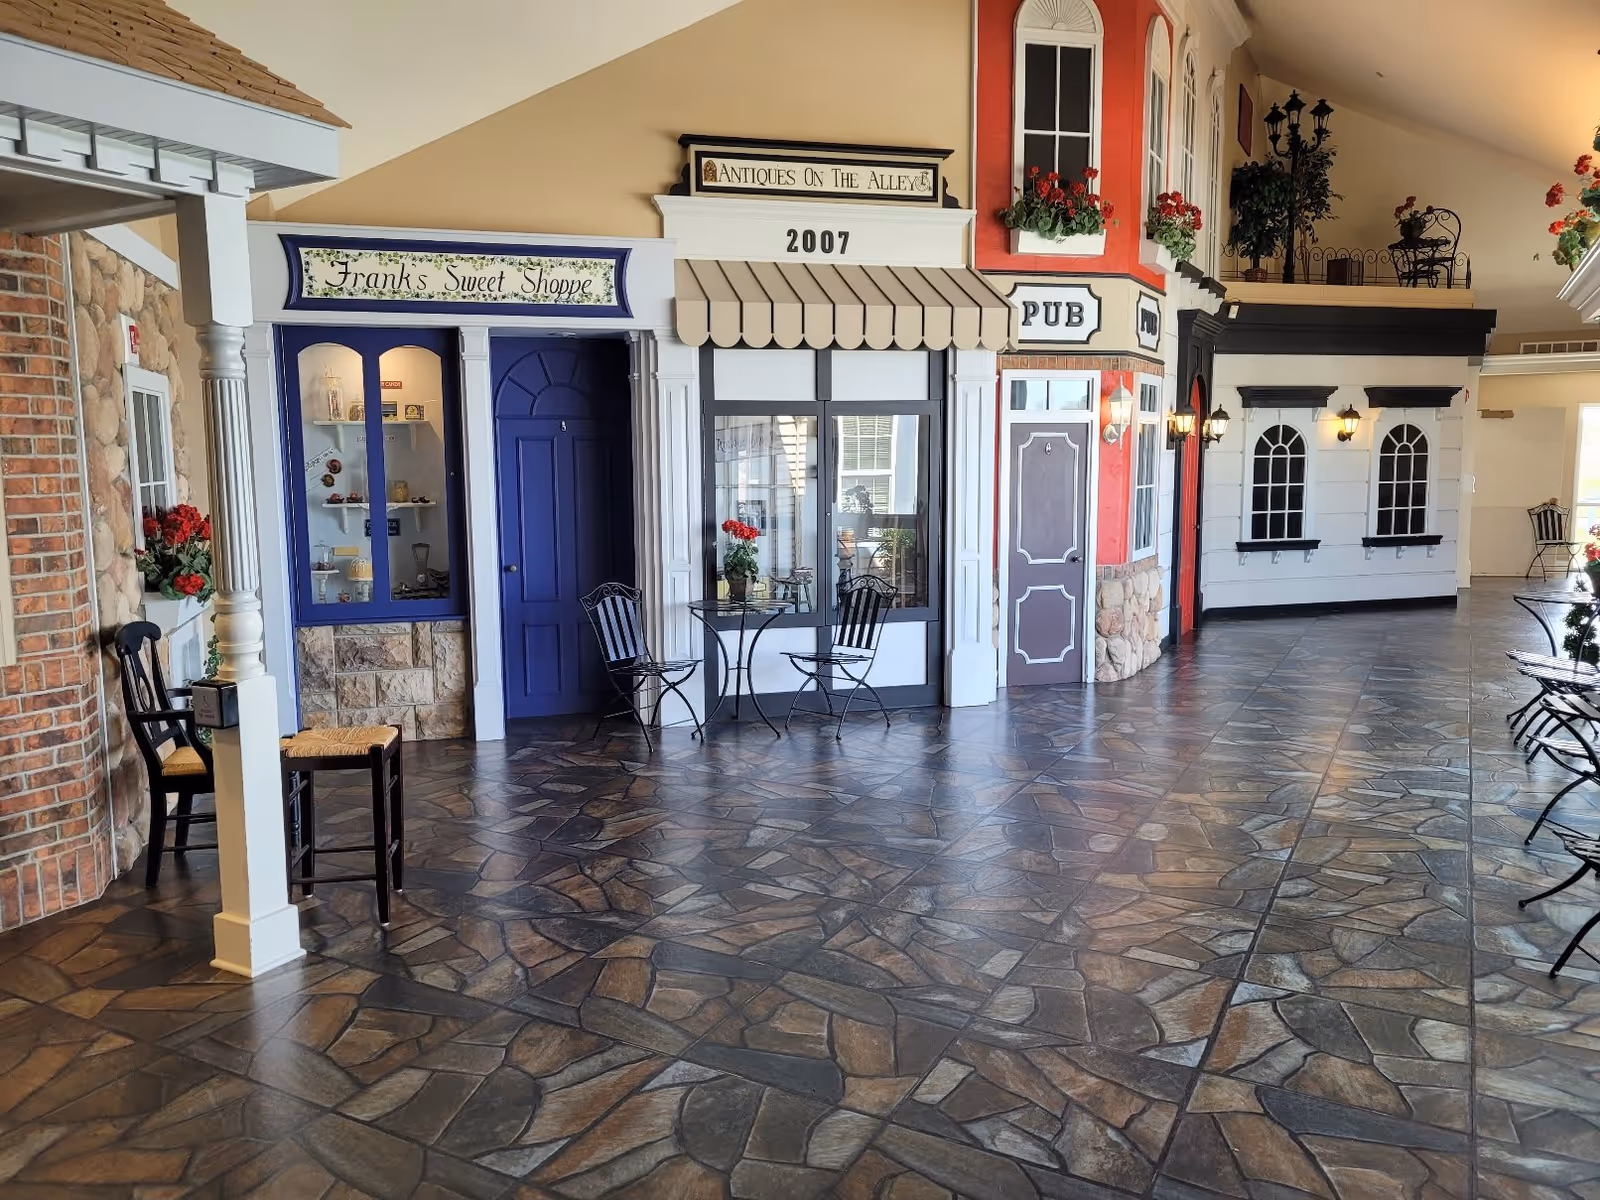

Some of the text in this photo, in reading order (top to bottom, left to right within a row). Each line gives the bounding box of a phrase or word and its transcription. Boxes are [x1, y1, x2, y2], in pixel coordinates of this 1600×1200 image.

[719, 163, 916, 191] ANTIQUES ON THE ALLEY
[786, 228, 850, 255] 2007
[325, 260, 592, 299] Frank's Sweet Shoppe
[1022, 301, 1085, 327] PUB
